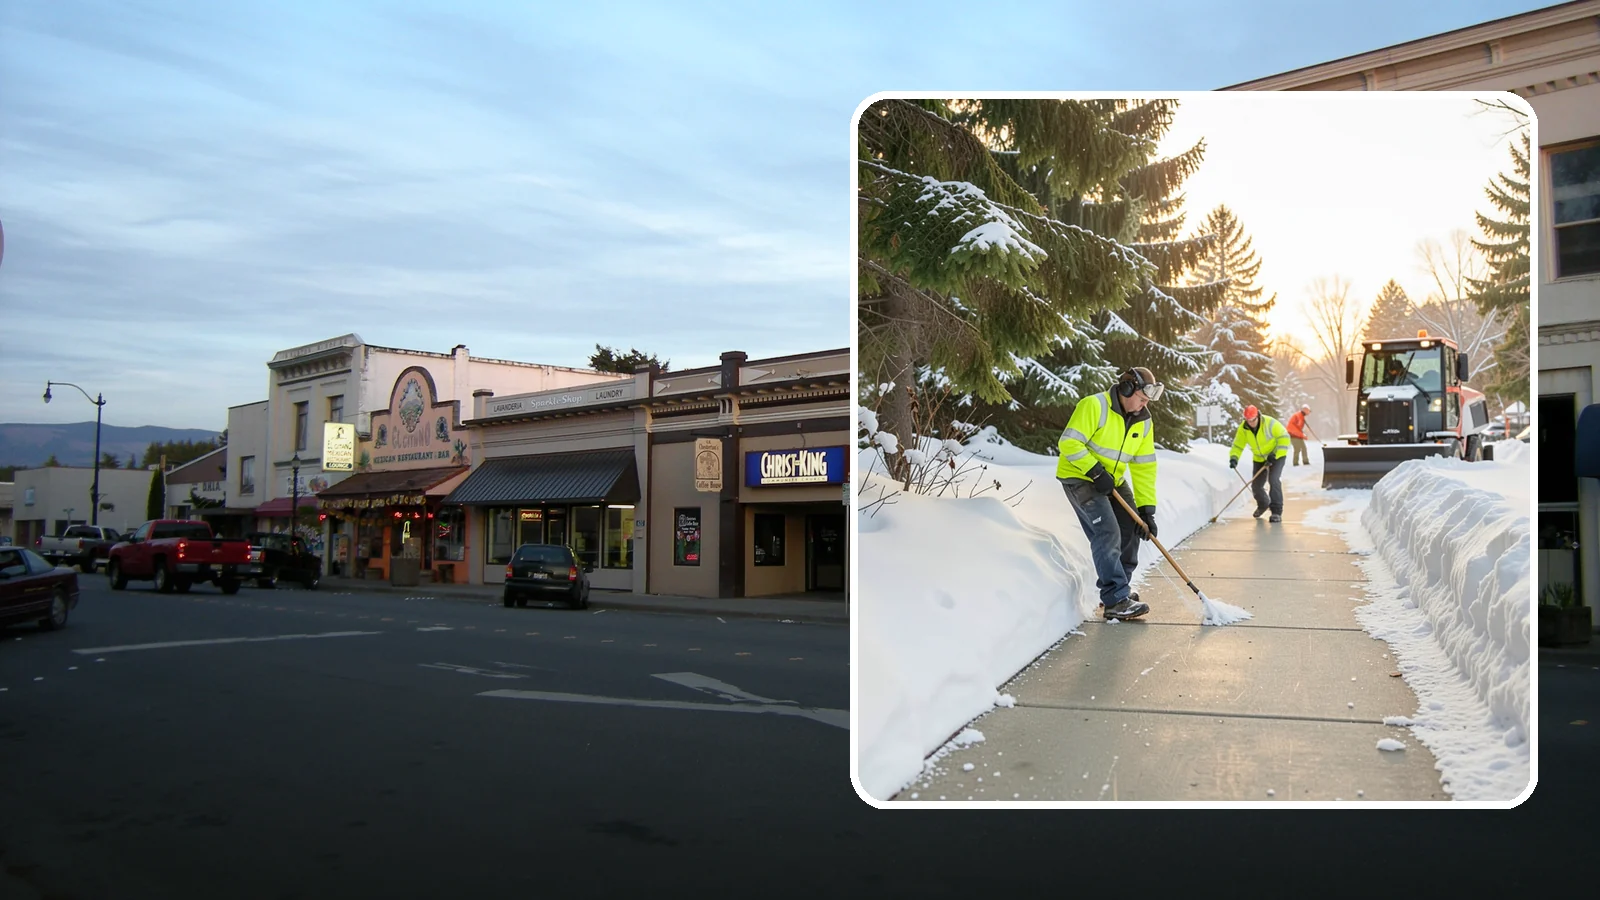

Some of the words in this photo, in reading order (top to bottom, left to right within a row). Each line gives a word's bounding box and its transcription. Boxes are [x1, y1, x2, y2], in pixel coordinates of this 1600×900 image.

[596, 389, 623, 400] LAUNDRY
[493, 402, 522, 413] LAVANDERIA
[531, 398, 561, 408] Sparkle
[562, 395, 583, 404] Shop
[373, 454, 396, 464] MEXICAN
[397, 451, 433, 462] RESTAURANT
[437, 450, 450, 459] BAR
[761, 452, 797, 477] CHRIST
[799, 450, 827, 476] KING
